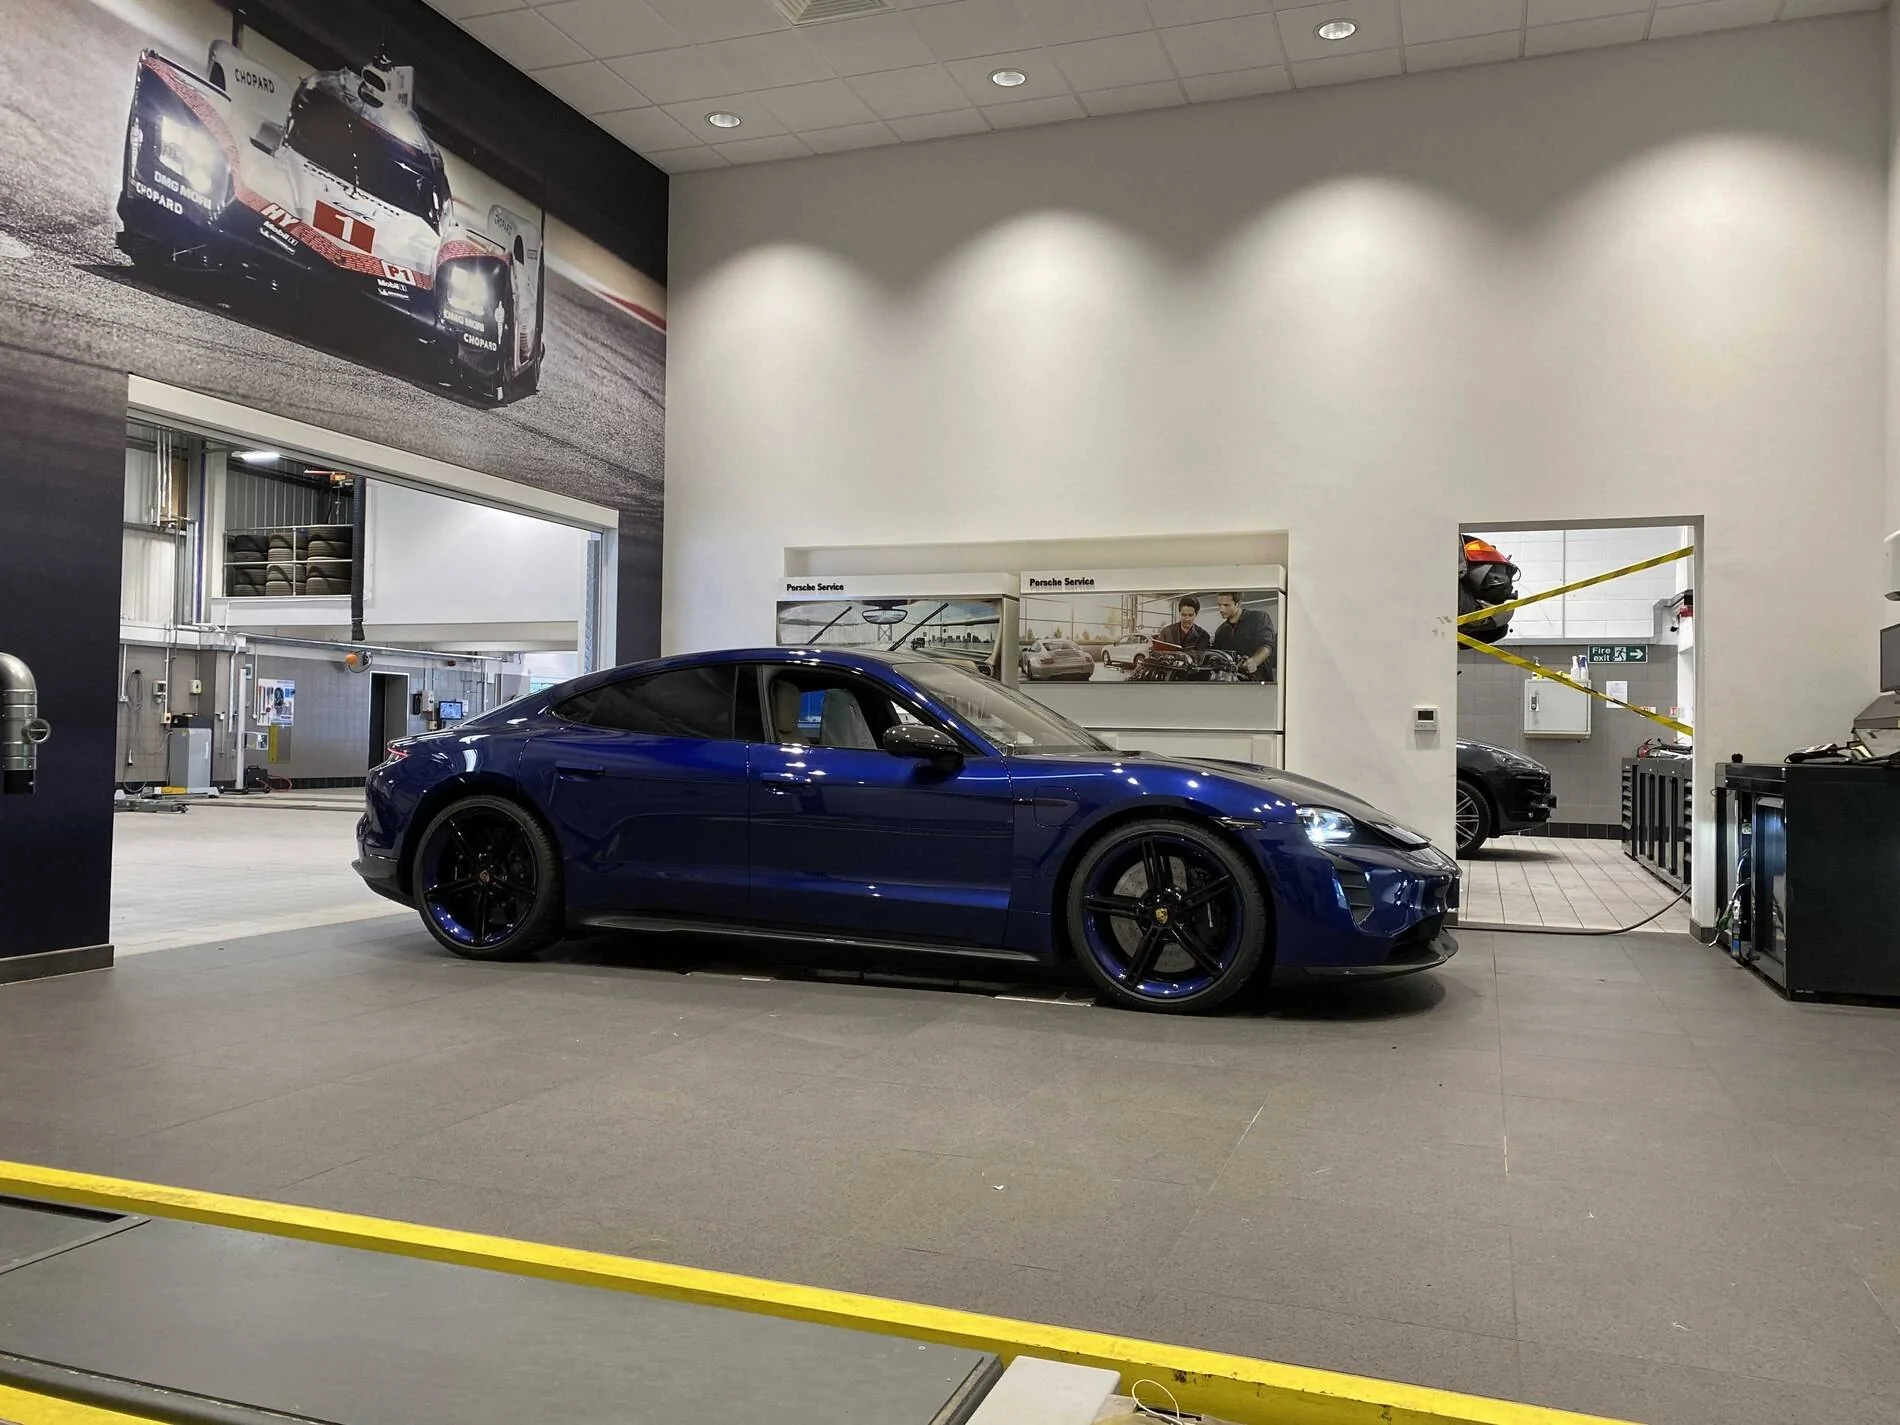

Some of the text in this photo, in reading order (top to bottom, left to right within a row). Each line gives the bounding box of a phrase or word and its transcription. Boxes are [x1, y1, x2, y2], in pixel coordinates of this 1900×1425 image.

[234, 68, 275, 94] CHOPARD
[135, 181, 183, 215] CHOPARD
[260, 202, 300, 228] HY
[263, 220, 290, 240] Mobil
[334, 213, 354, 243] 1
[463, 332, 498, 352] CHOPARD
[786, 582, 845, 592] Porsche Service
[1029, 576, 1095, 587] Porsche Service
[1592, 646, 1611, 655] Fire
[1593, 654, 1611, 662] exit
